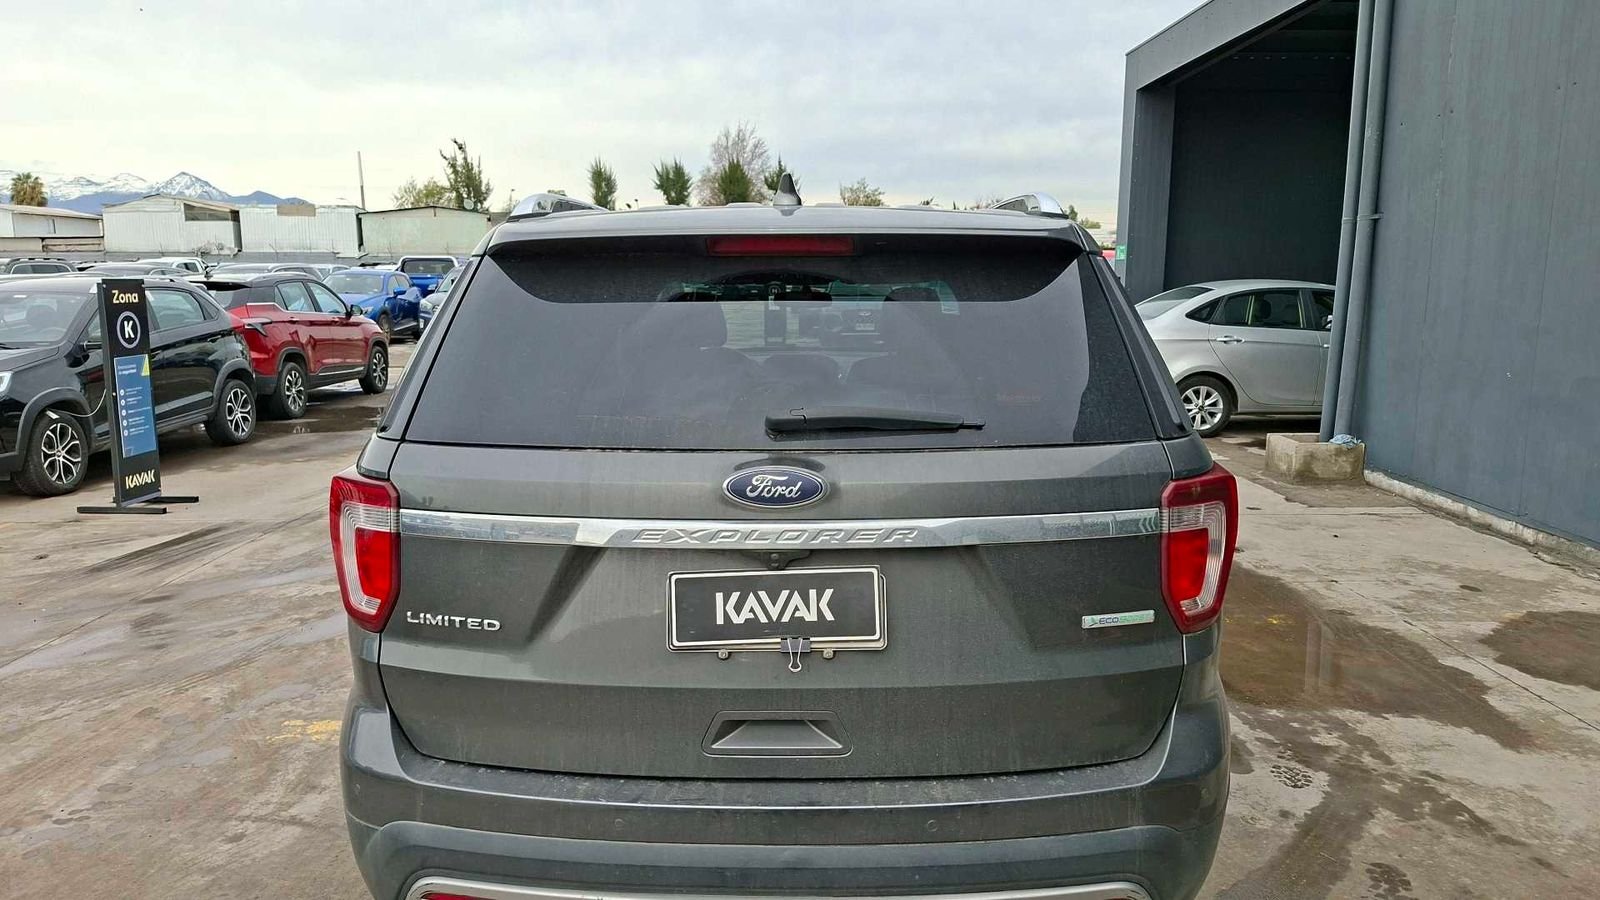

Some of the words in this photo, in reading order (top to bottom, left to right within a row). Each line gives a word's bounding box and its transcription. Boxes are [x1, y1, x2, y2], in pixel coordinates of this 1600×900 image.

[111, 289, 139, 304] Zona
[123, 320, 135, 339] K
[125, 469, 155, 489] KAVAK
[746, 474, 802, 498] Ford
[631, 527, 918, 544] EXPLORER
[715, 588, 835, 625] KAVAK
[406, 611, 501, 631] LIMITED
